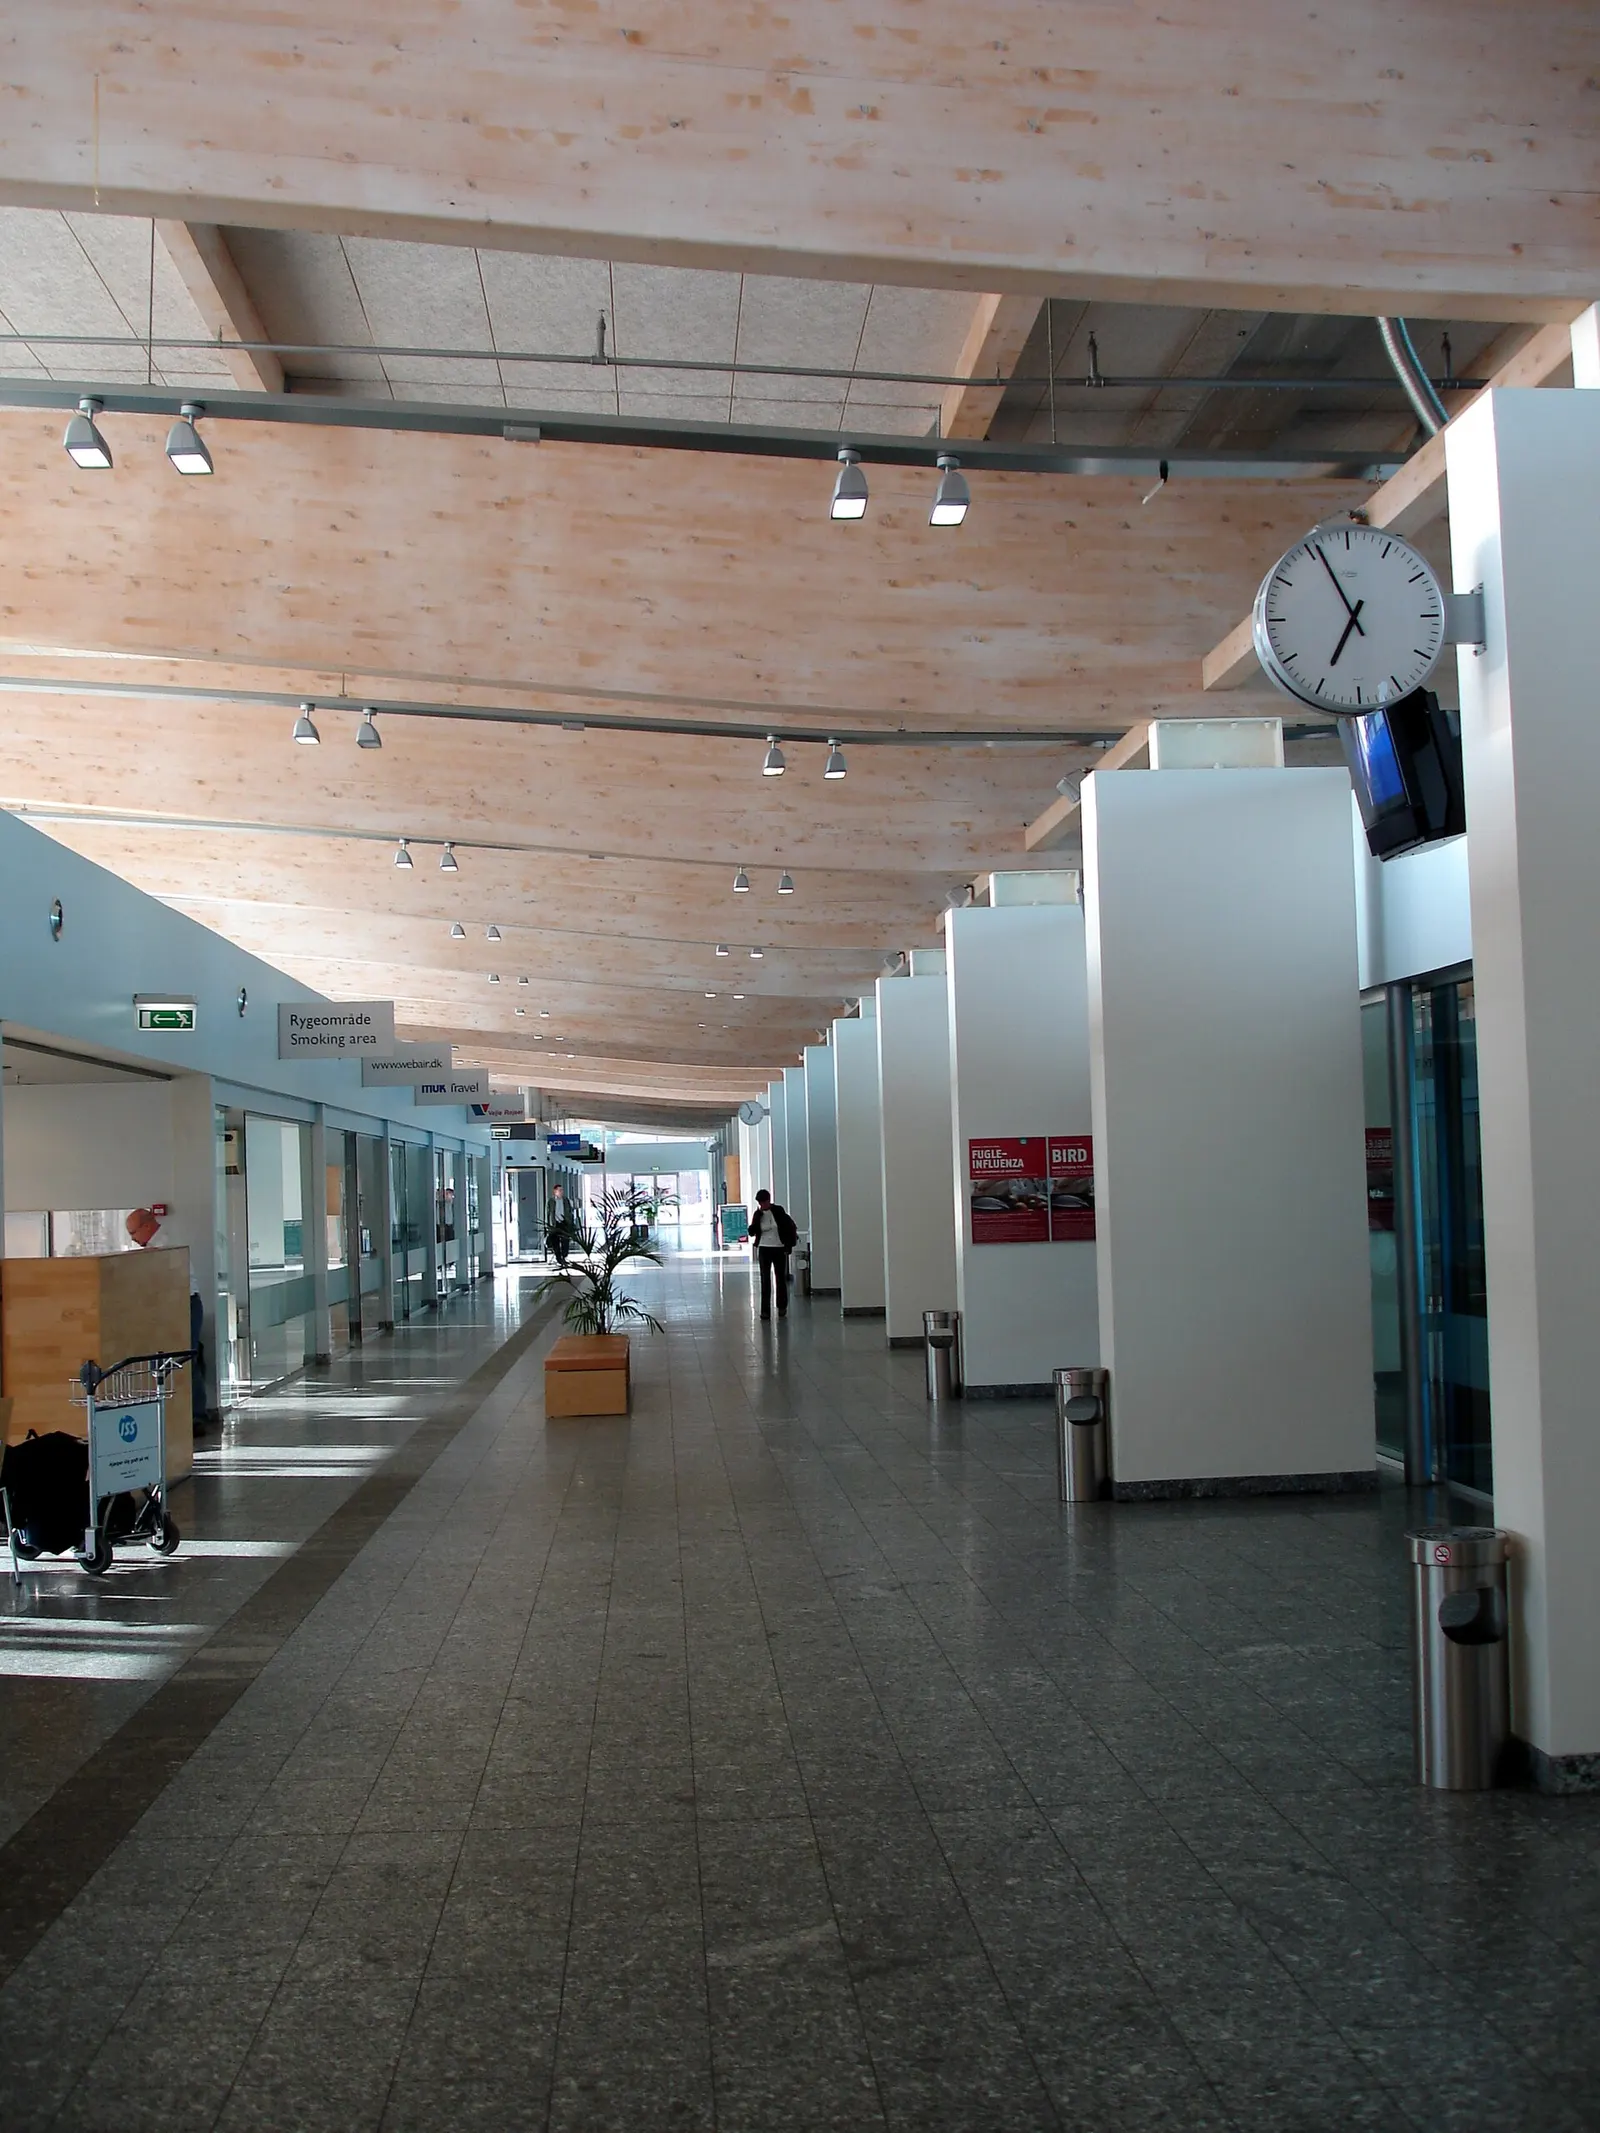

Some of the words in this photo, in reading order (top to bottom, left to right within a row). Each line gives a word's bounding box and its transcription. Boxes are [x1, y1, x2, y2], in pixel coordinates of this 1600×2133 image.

[290, 1013, 371, 1030] Rygeområde
[291, 1033, 346, 1048] Smoking
[349, 1035, 377, 1044] area
[371, 1058, 443, 1070] www.webair.dk
[971, 1149, 1008, 1159] FUGLE-
[1051, 1148, 1088, 1163] BIRD
[972, 1158, 1025, 1169] INFLUENZA
[120, 1421, 135, 1436] ISS
